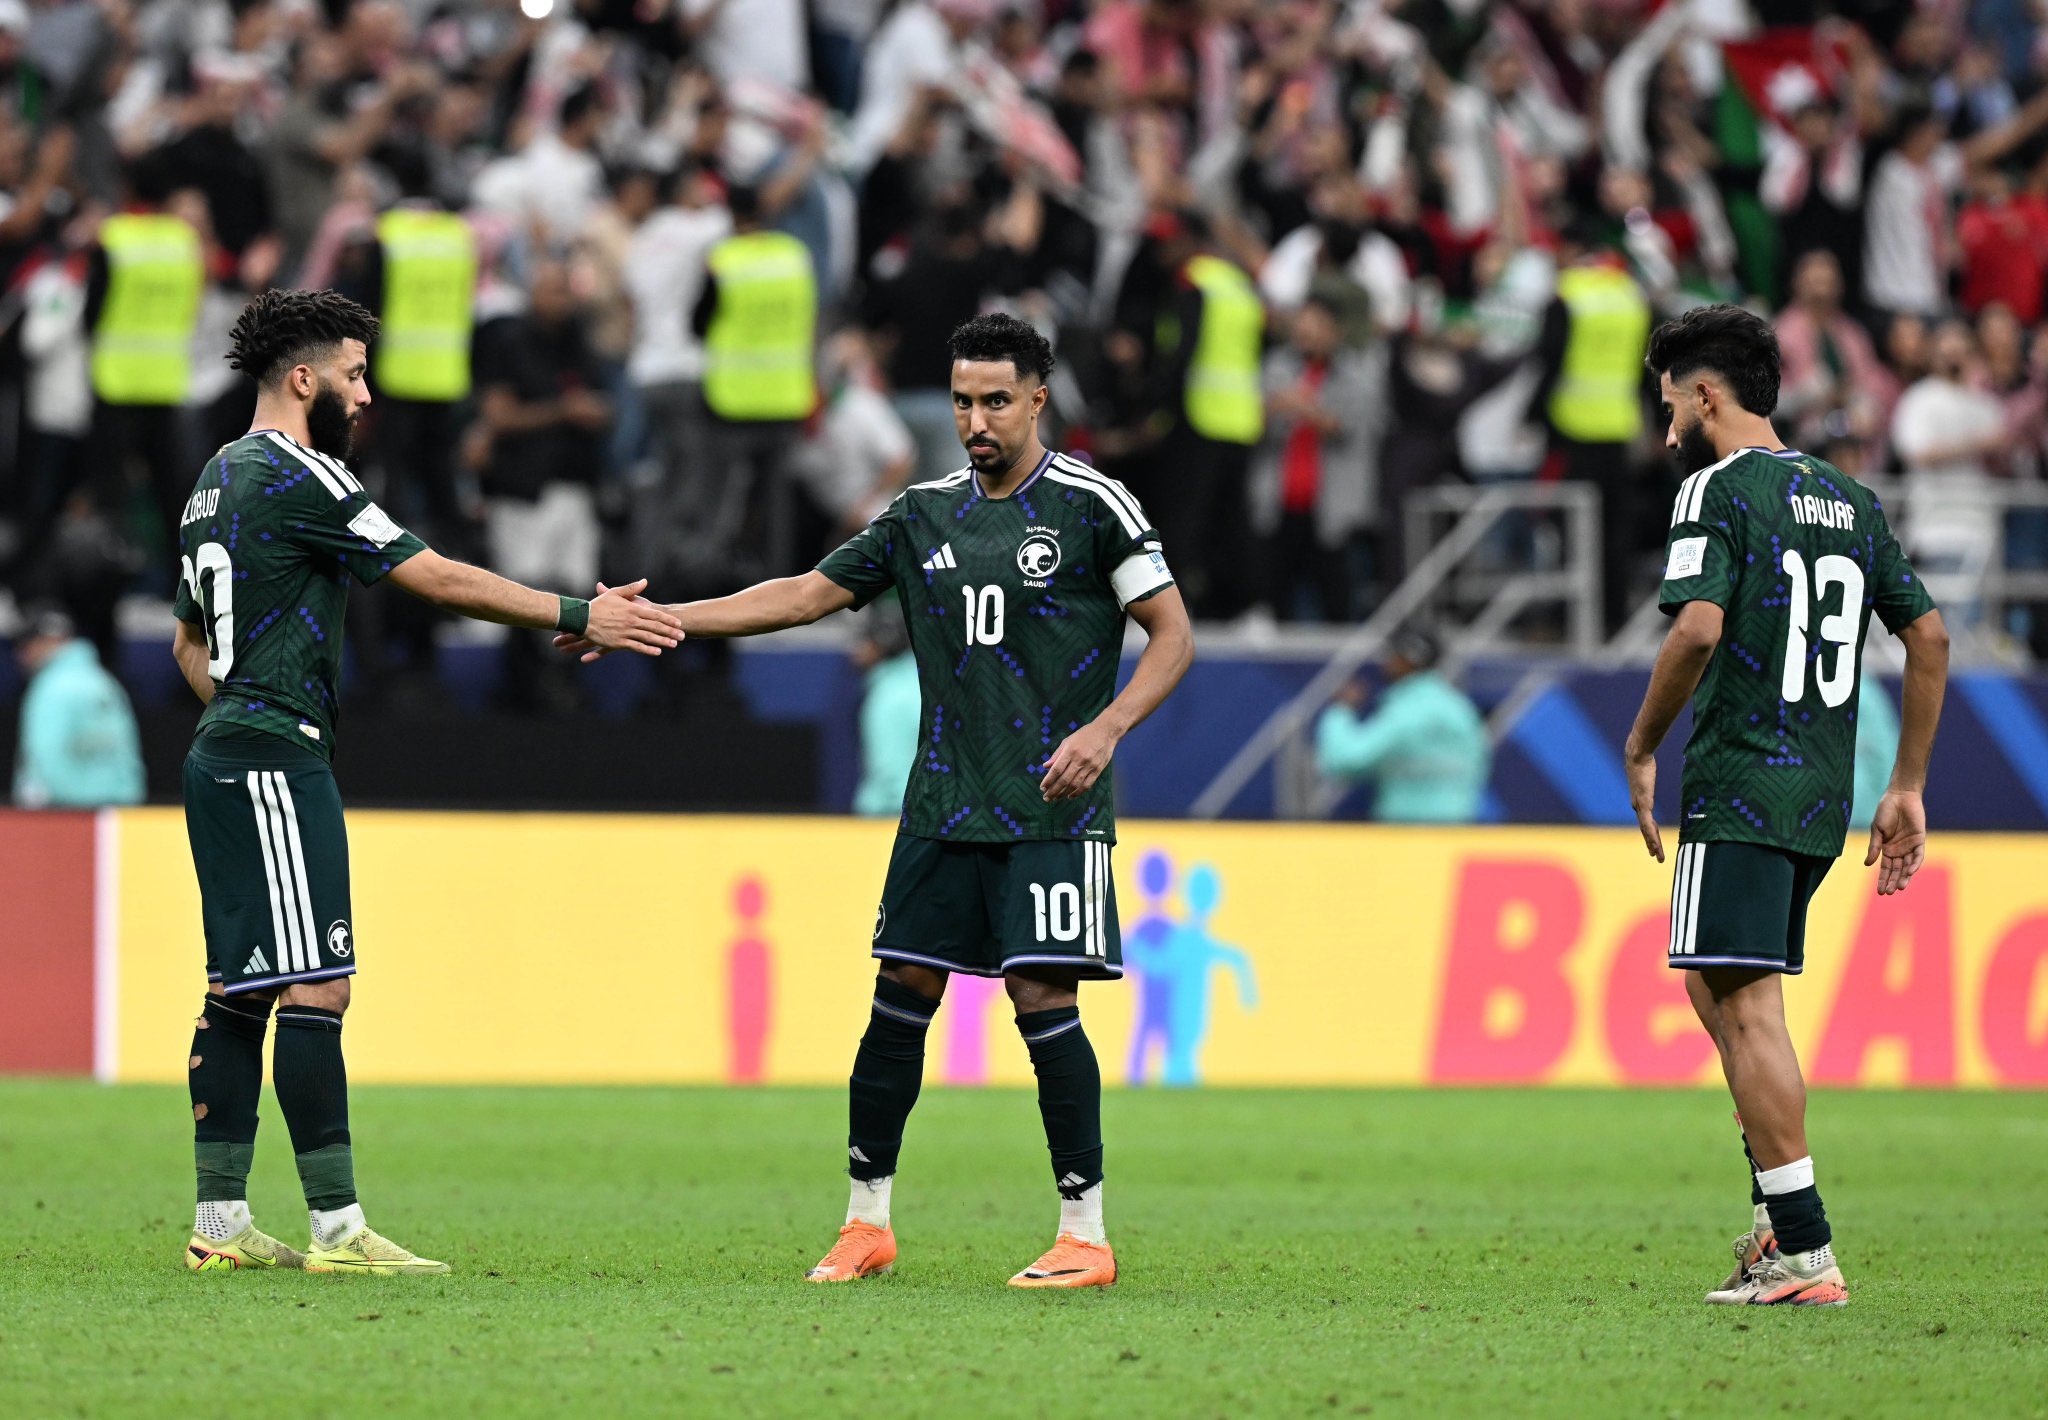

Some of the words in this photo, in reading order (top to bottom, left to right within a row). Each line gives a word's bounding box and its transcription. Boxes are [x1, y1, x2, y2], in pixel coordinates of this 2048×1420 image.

[180, 488, 220, 528] LOBUD
[1026, 525, 1060, 537] السعودية
[1791, 495, 1855, 531] NAWAF
[1023, 580, 1047, 588] SAUDI
[962, 584, 1004, 645] 10
[1782, 549, 1865, 708] 13
[1029, 882, 1080, 941] 10
[1427, 857, 1720, 1085] Be
